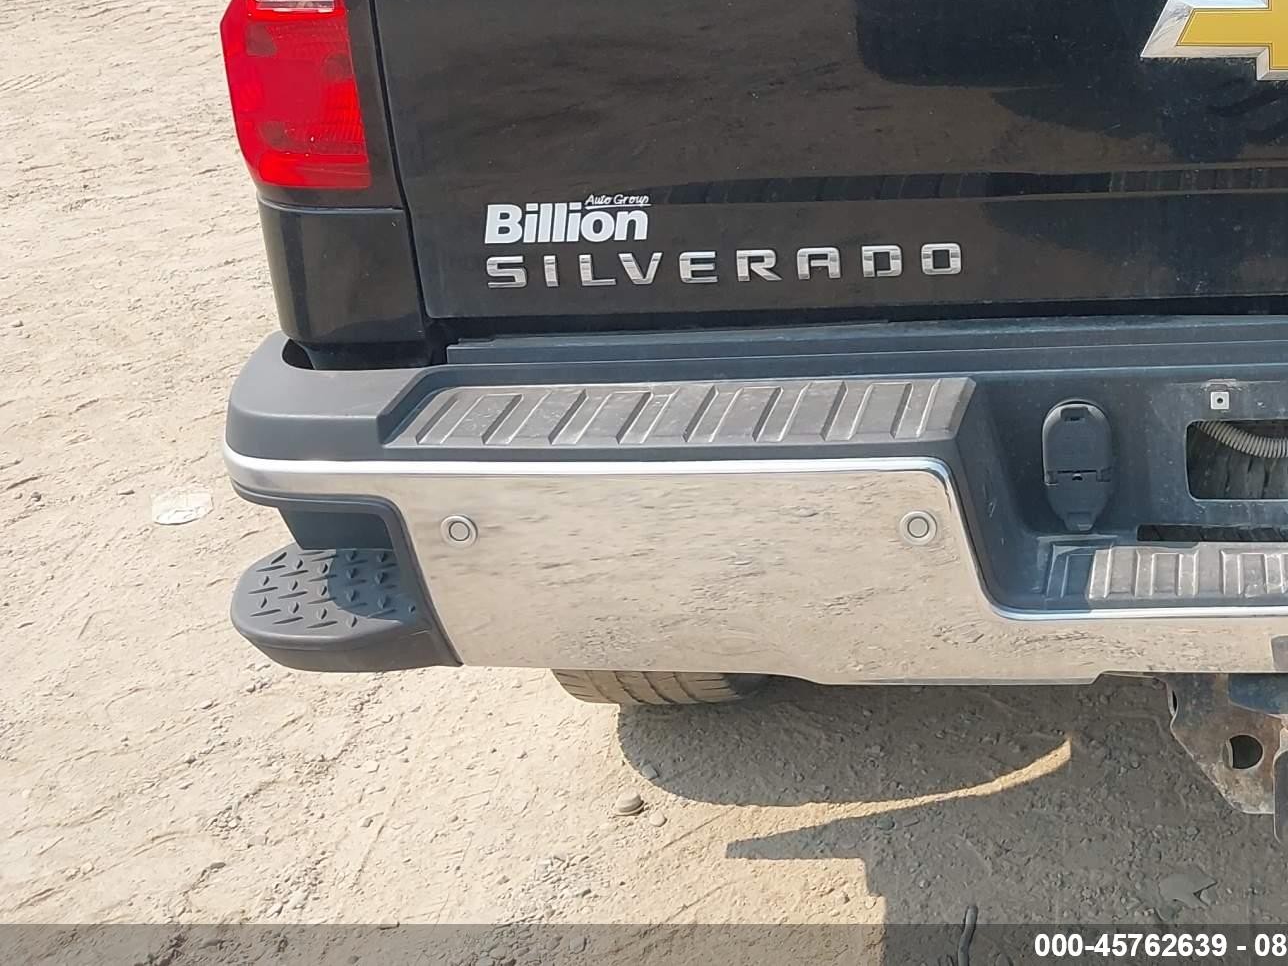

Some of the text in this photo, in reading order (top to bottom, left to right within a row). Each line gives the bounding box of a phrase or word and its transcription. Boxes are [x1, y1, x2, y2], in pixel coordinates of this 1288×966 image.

[583, 193, 650, 207] Auto Group
[484, 202, 649, 244] Billion
[486, 242, 963, 289] SILVERADO
